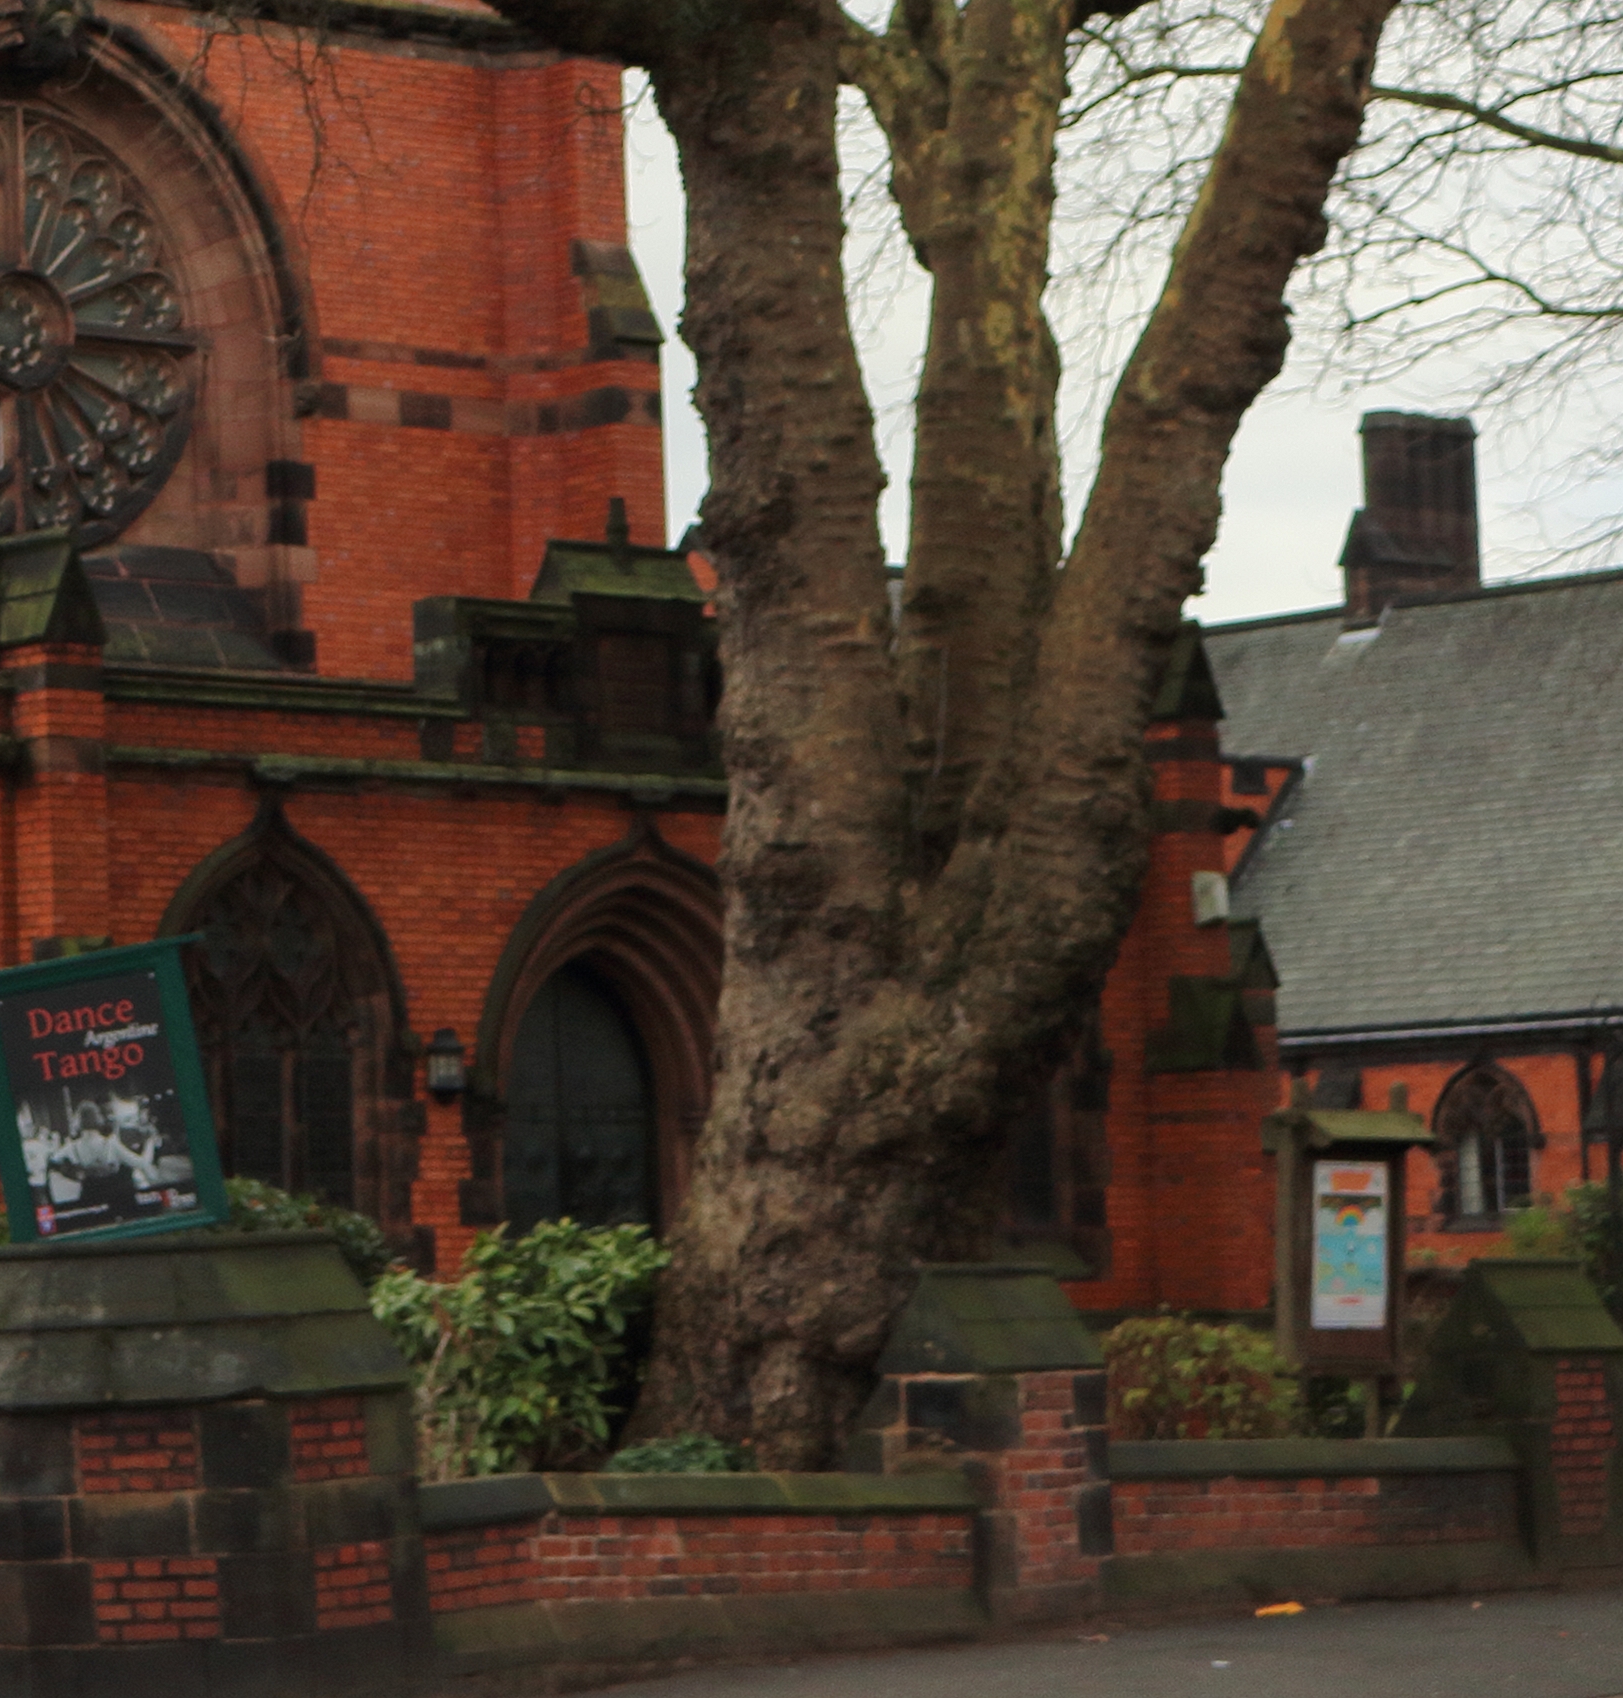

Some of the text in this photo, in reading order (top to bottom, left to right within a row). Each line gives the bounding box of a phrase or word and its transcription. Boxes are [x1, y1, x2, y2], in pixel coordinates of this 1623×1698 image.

[26, 998, 134, 1039] Dance
[84, 1022, 158, 1048] Argentine
[32, 1042, 144, 1081] Tango
